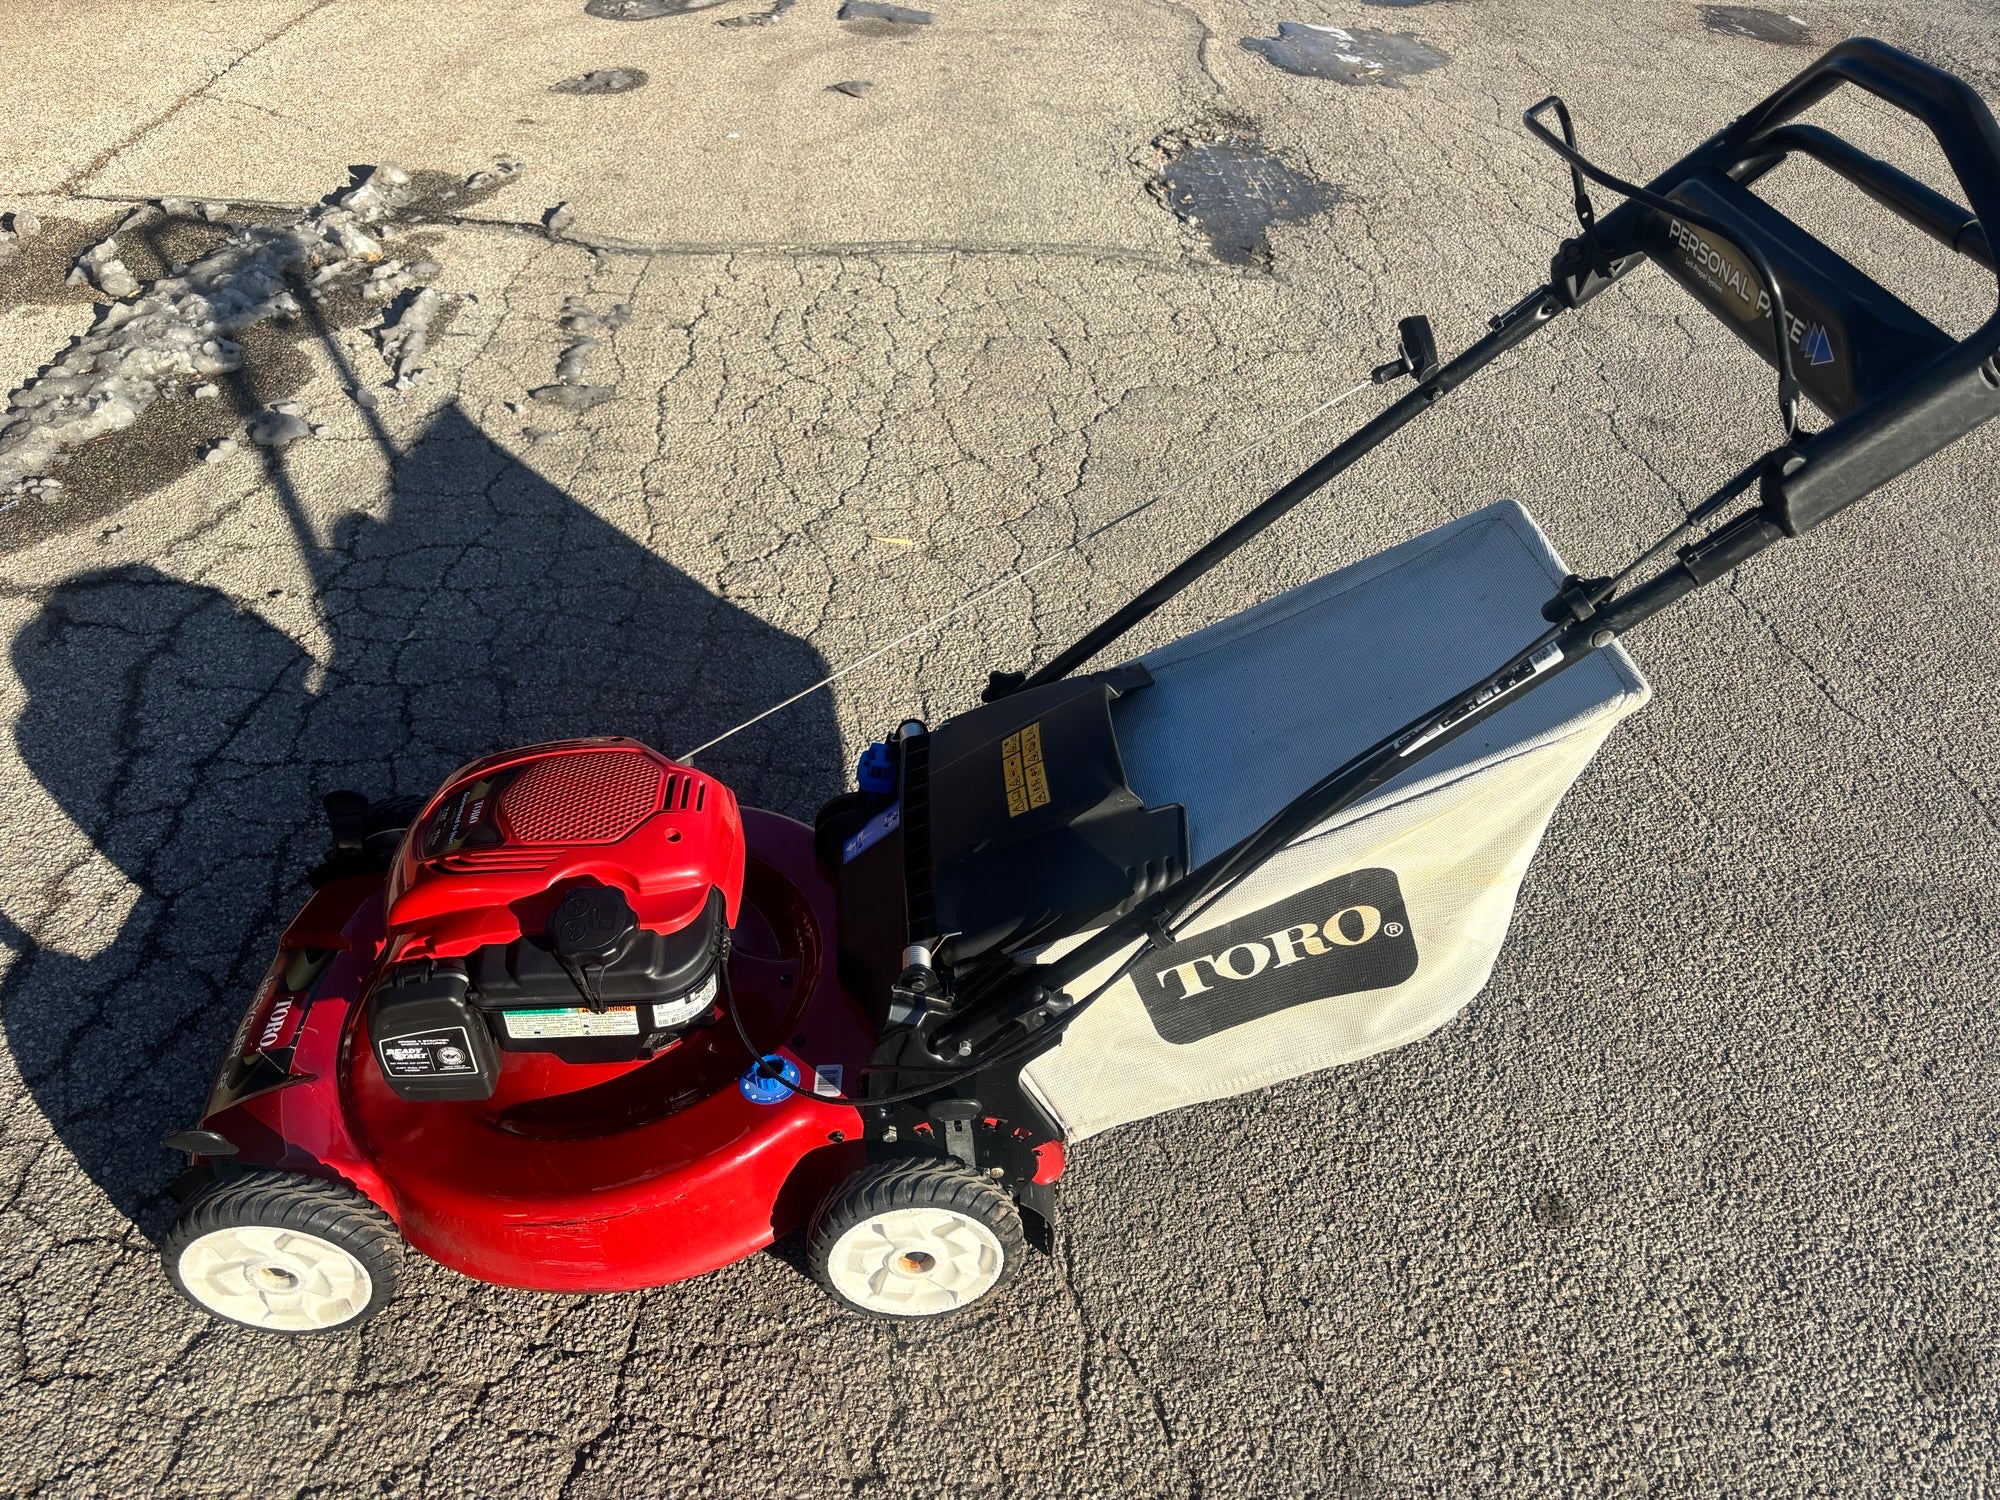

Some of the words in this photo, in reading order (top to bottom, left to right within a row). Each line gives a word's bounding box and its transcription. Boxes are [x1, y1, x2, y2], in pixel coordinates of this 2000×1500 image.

[1668, 218, 1750, 302] PERSONAL
[1756, 289, 1807, 345] PE
[469, 799, 484, 824] TORO
[1156, 905, 1382, 1000] TORO
[228, 975, 274, 1060] RECYCLER
[260, 996, 294, 1047] TORO
